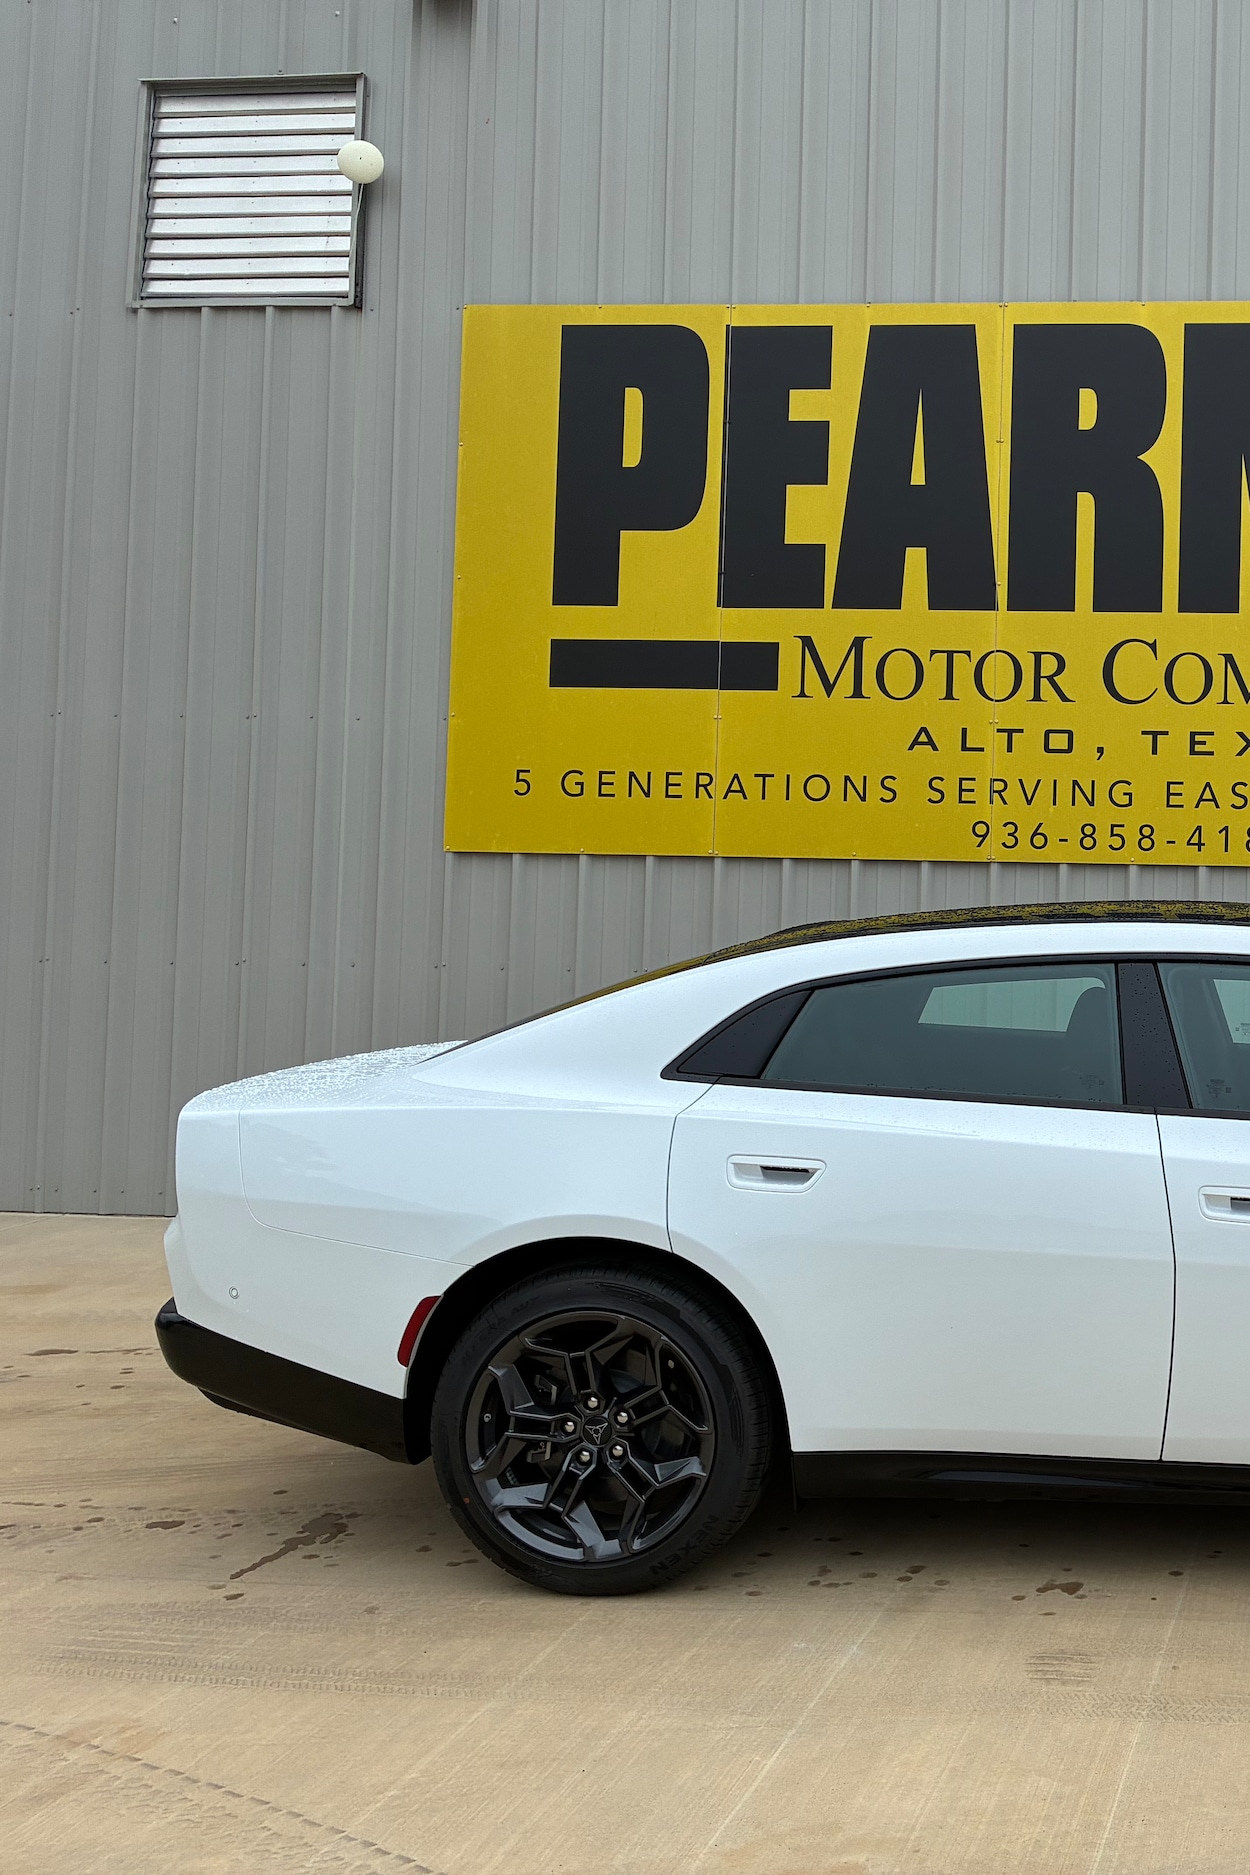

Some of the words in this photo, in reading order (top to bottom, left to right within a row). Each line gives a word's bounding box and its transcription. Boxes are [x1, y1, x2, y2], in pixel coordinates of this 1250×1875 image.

[792, 635, 1077, 703] MOTOR
[907, 726, 1106, 761] ALTO,
[514, 769, 532, 797] 5
[560, 769, 897, 804] GENERATIONS
[927, 776, 1134, 809] SERVING
[649, 1514, 720, 1576] NEXEN
